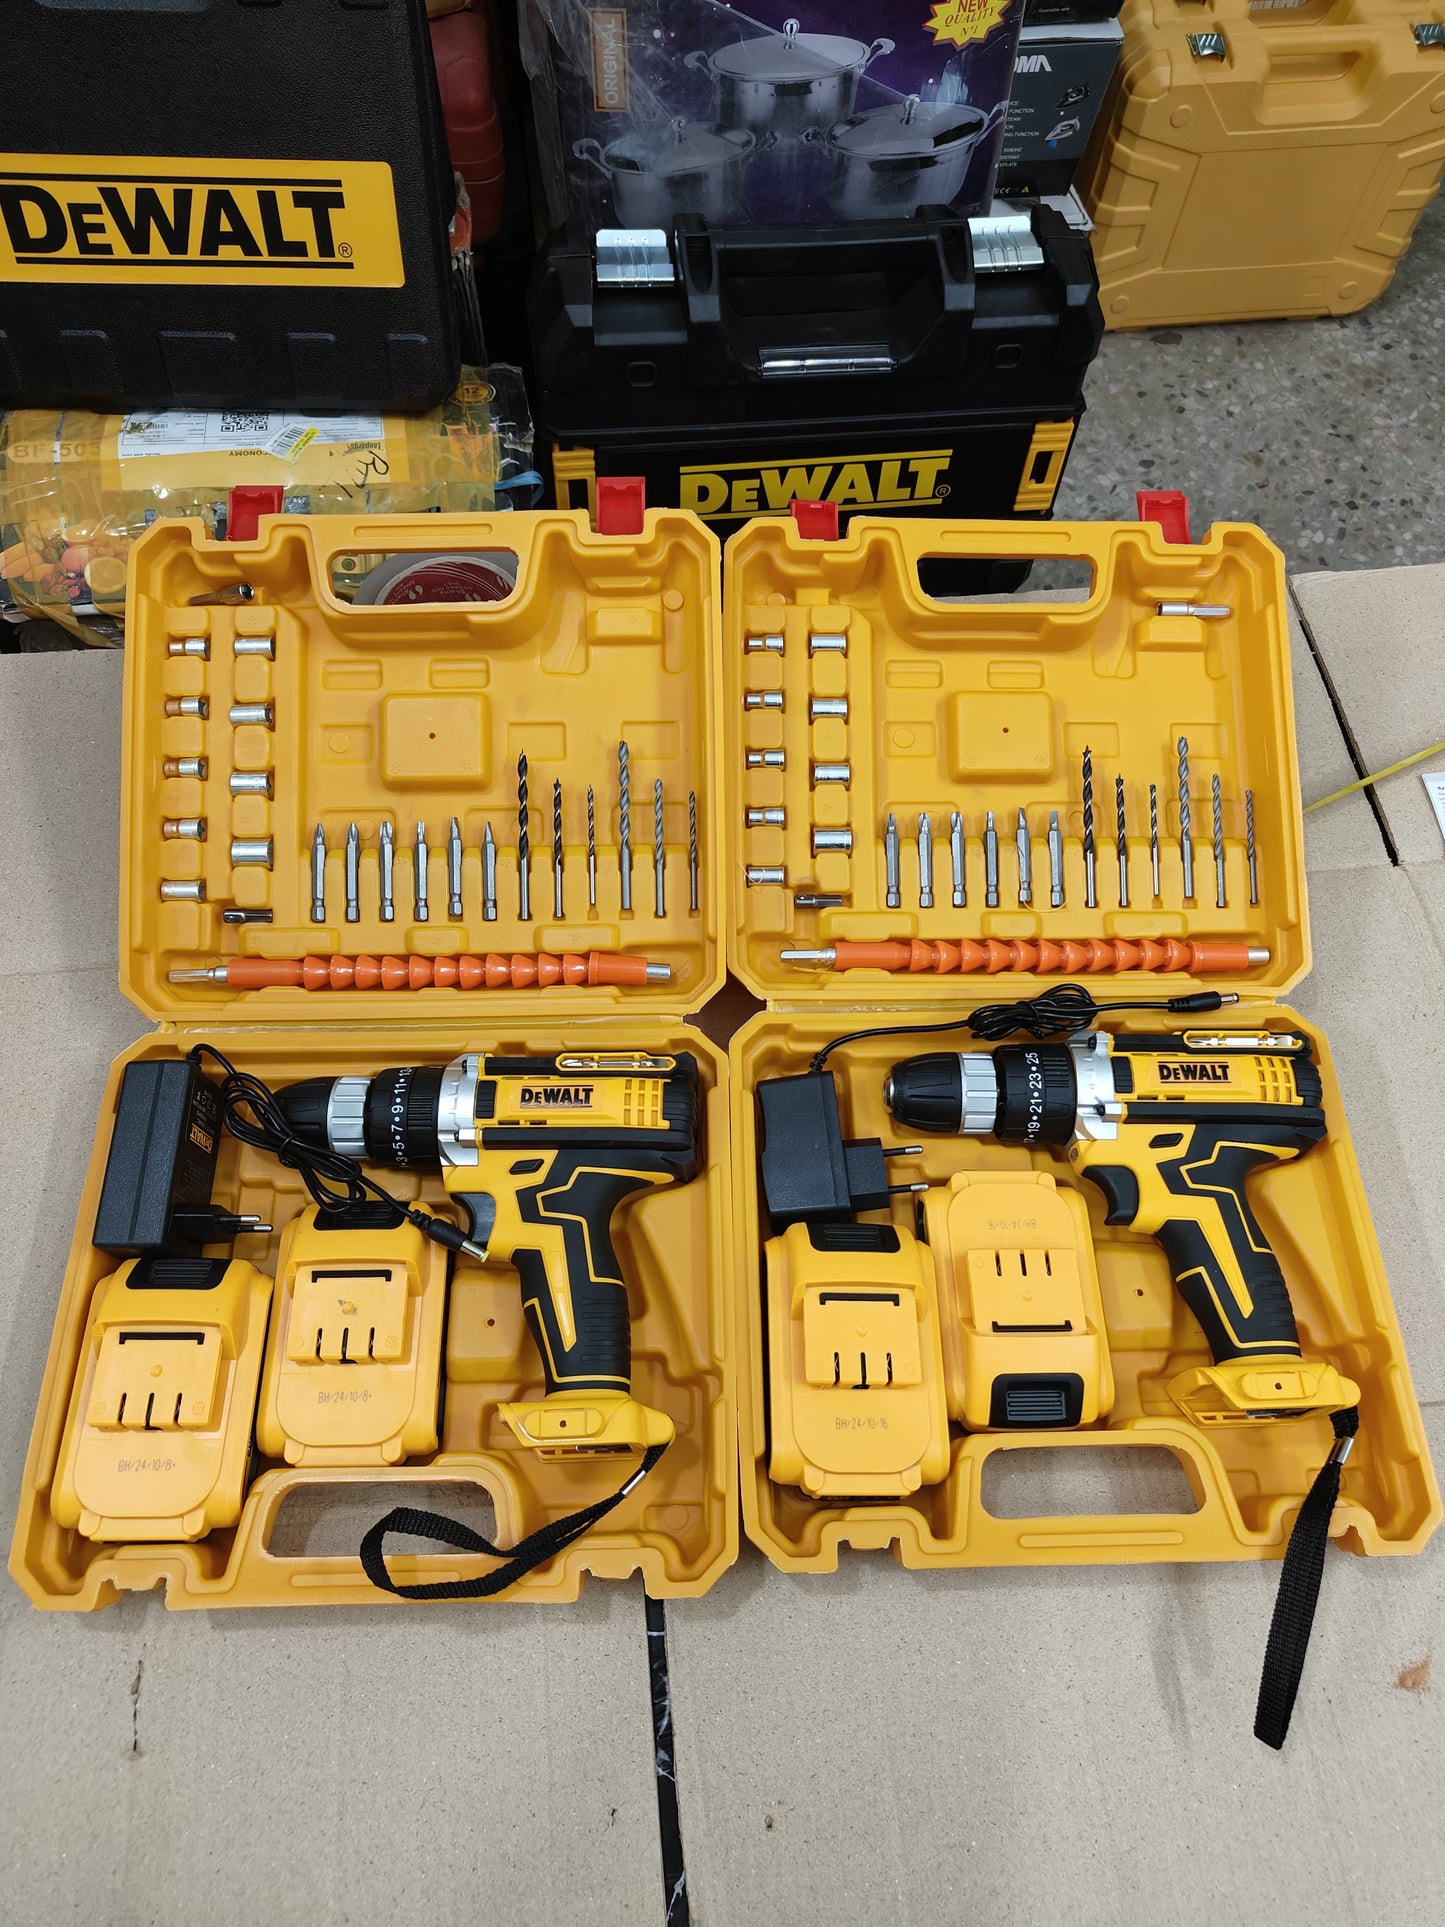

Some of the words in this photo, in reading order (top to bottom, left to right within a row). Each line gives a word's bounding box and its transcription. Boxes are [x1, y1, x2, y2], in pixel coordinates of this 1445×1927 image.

[957, 0, 988, 13] NEW
[944, 6, 996, 27] QUALITY
[603, 18, 618, 104] ORIGINAL
[1025, 1052, 1040, 1065] 25
[1028, 1073, 1042, 1089] 23
[393, 1083, 407, 1095] 11
[391, 1105, 404, 1114] 9
[1029, 1099, 1043, 1114] 21
[391, 1124, 404, 1133] 7
[1027, 1121, 1041, 1133] 19
[392, 1142, 405, 1150] 5
